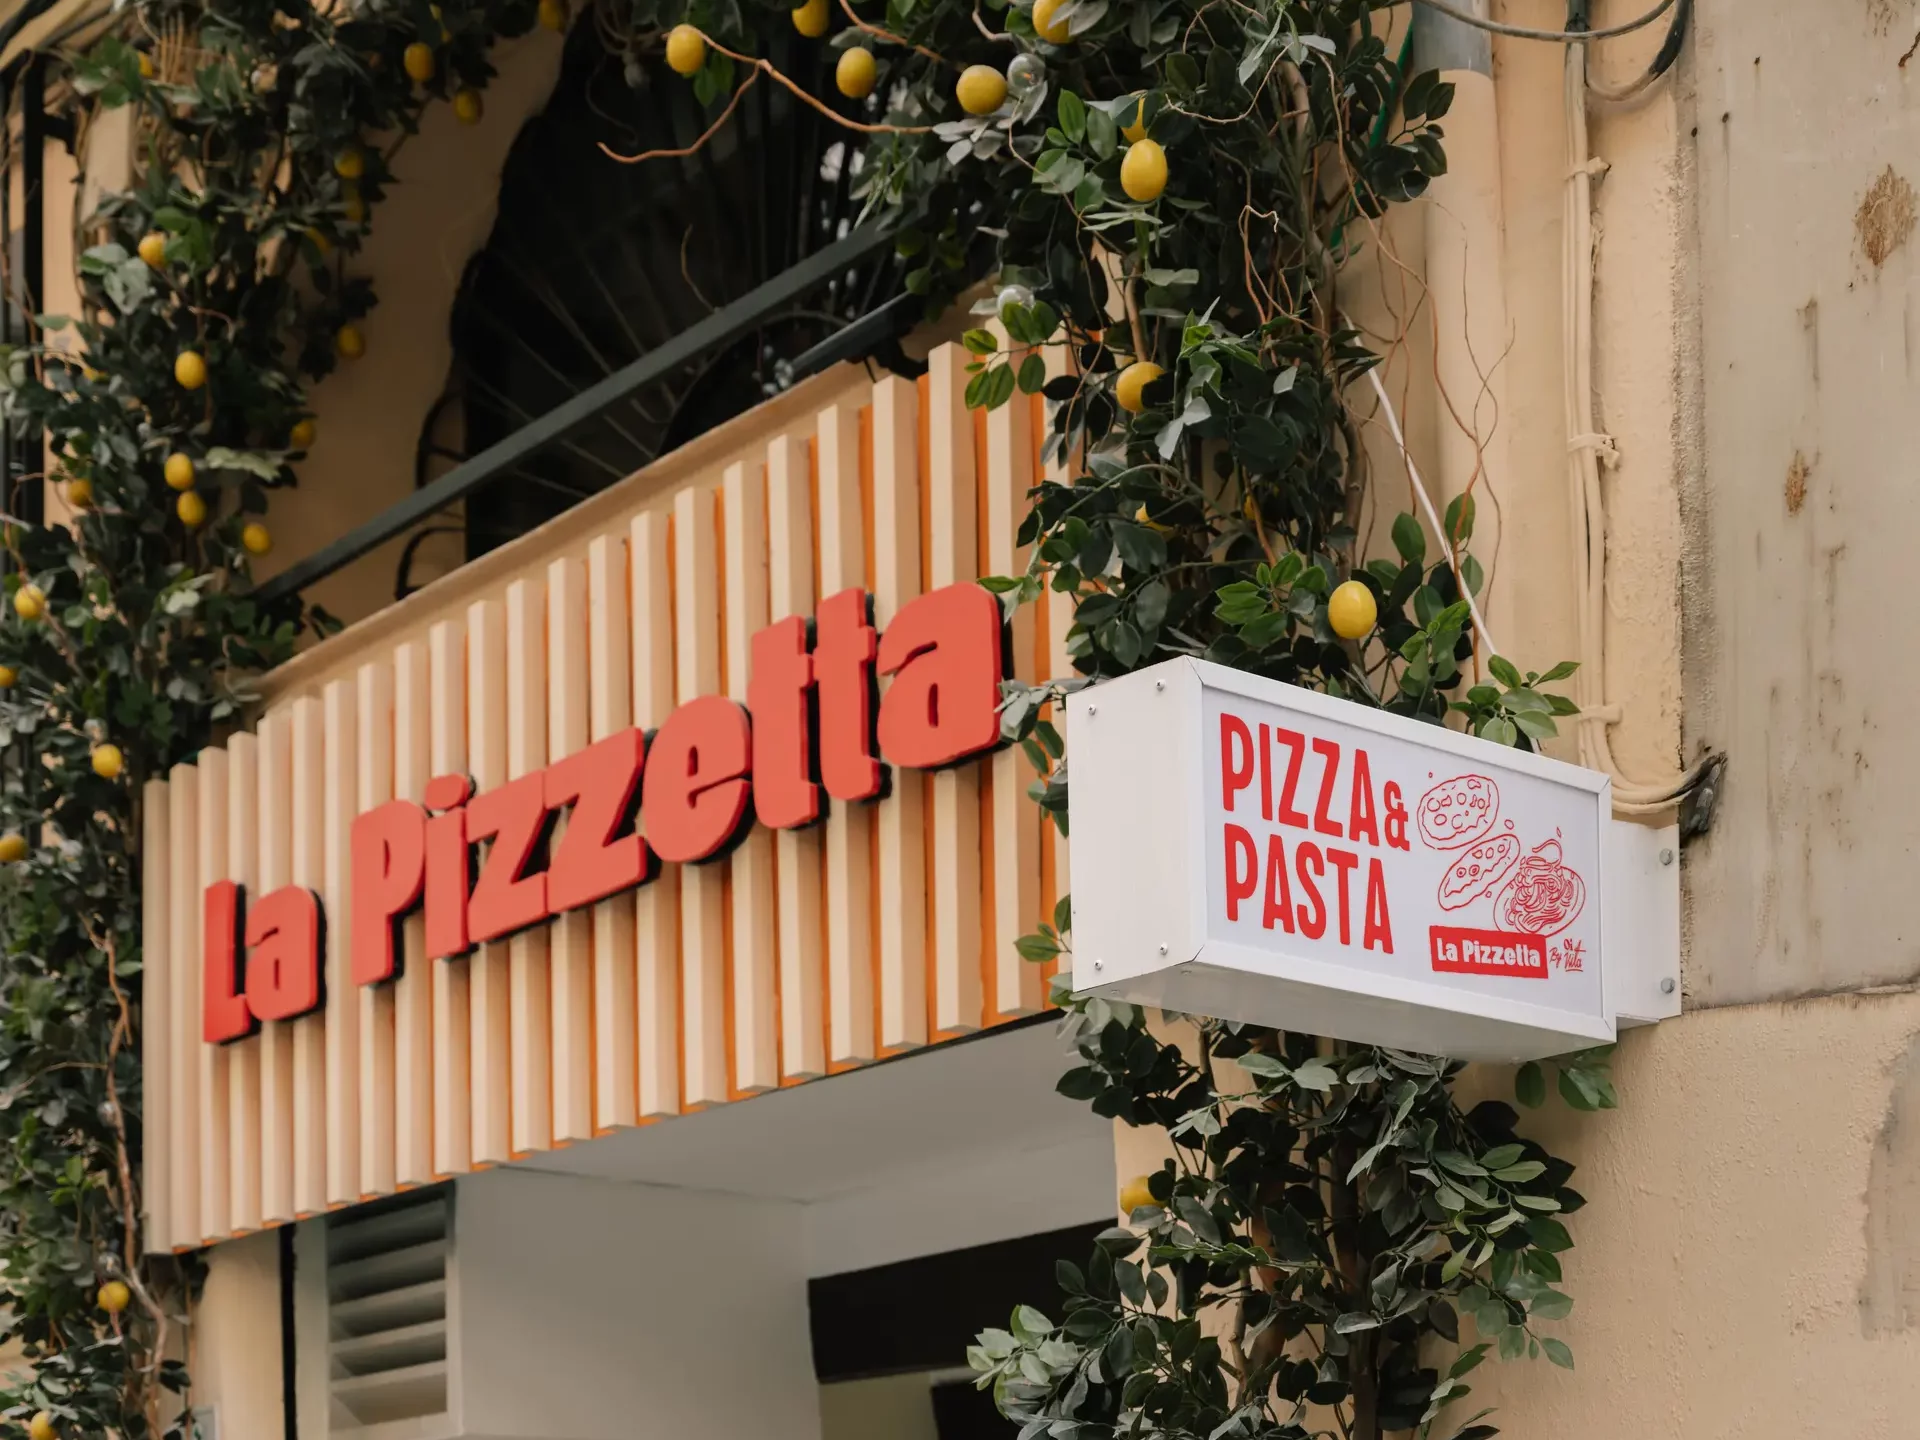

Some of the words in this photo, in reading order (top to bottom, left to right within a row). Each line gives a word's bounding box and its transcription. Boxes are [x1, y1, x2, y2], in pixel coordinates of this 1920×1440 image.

[204, 879, 319, 1043] La
[351, 582, 1001, 985] Pizzetta
[1224, 823, 1394, 954] PASTA
[1437, 938, 1458, 962] La
[1462, 939, 1541, 967] Pizzetta
